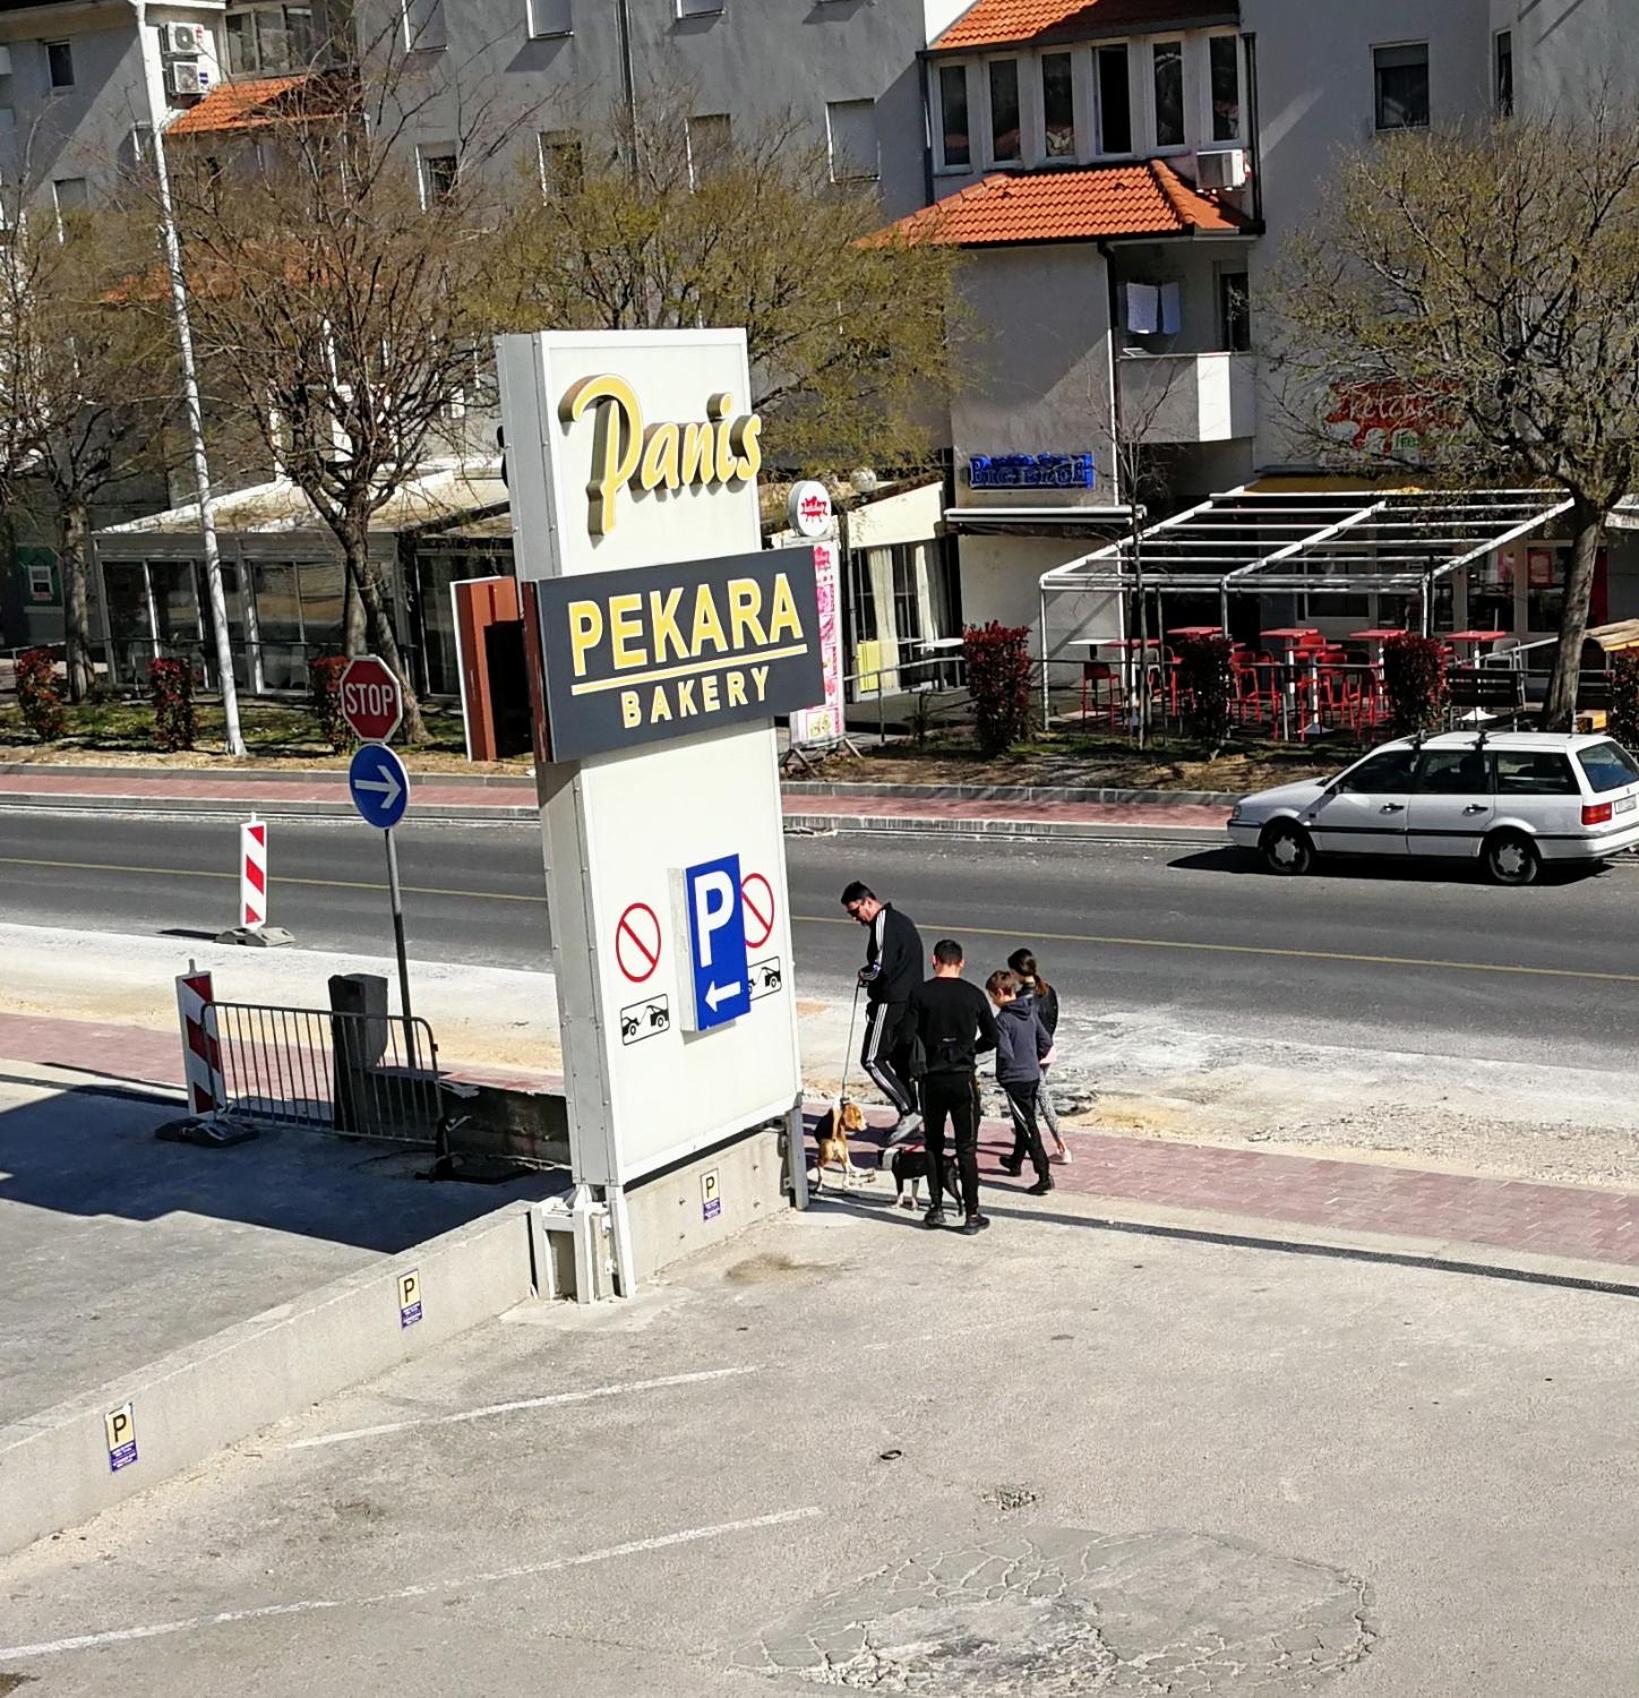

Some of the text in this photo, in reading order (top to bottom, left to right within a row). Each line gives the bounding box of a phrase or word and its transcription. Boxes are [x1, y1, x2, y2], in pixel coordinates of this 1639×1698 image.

[564, 374, 762, 536] Panis
[568, 572, 804, 677] PEKARA
[345, 683, 394, 716] STOP
[620, 665, 770, 729] BAKERY
[694, 870, 735, 968] P
[706, 1176, 715, 1198] P
[404, 1278, 415, 1303] P
[113, 1414, 127, 1443] P
